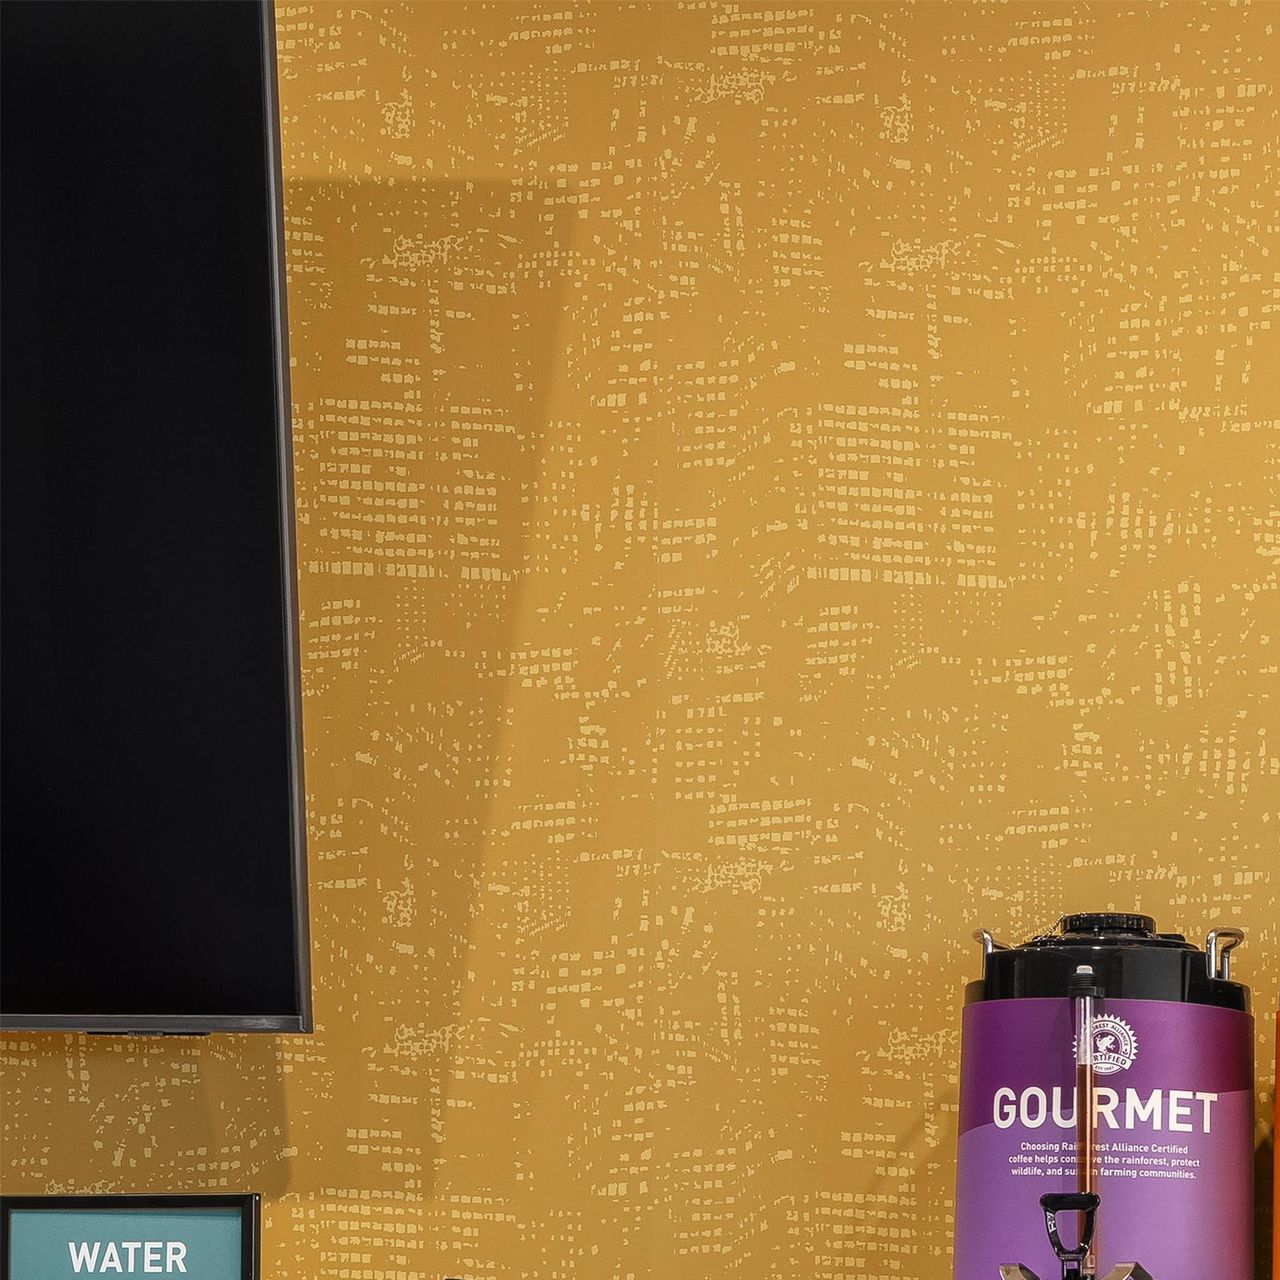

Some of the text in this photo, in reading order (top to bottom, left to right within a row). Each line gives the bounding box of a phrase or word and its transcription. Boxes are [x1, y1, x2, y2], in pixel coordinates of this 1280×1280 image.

[1093, 1054, 1127, 1066] RTIFIED
[993, 1086, 1219, 1134] GOURMET
[1020, 1142, 1060, 1152] Choosing
[1111, 1143, 1149, 1153] Alliance
[1151, 1143, 1189, 1154] Certified
[1008, 1154, 1034, 1163] coffee
[1035, 1154, 1059, 1165] helps
[1104, 1155, 1121, 1165] the
[1122, 1155, 1170, 1167] rainforest,
[1171, 1157, 1201, 1168] protect
[1011, 1167, 1045, 1177] wildlife,
[1046, 1167, 1063, 1176] and
[1100, 1167, 1138, 1179] farming
[1139, 1169, 1197, 1180] communities.
[68, 1240, 188, 1274] WATER
